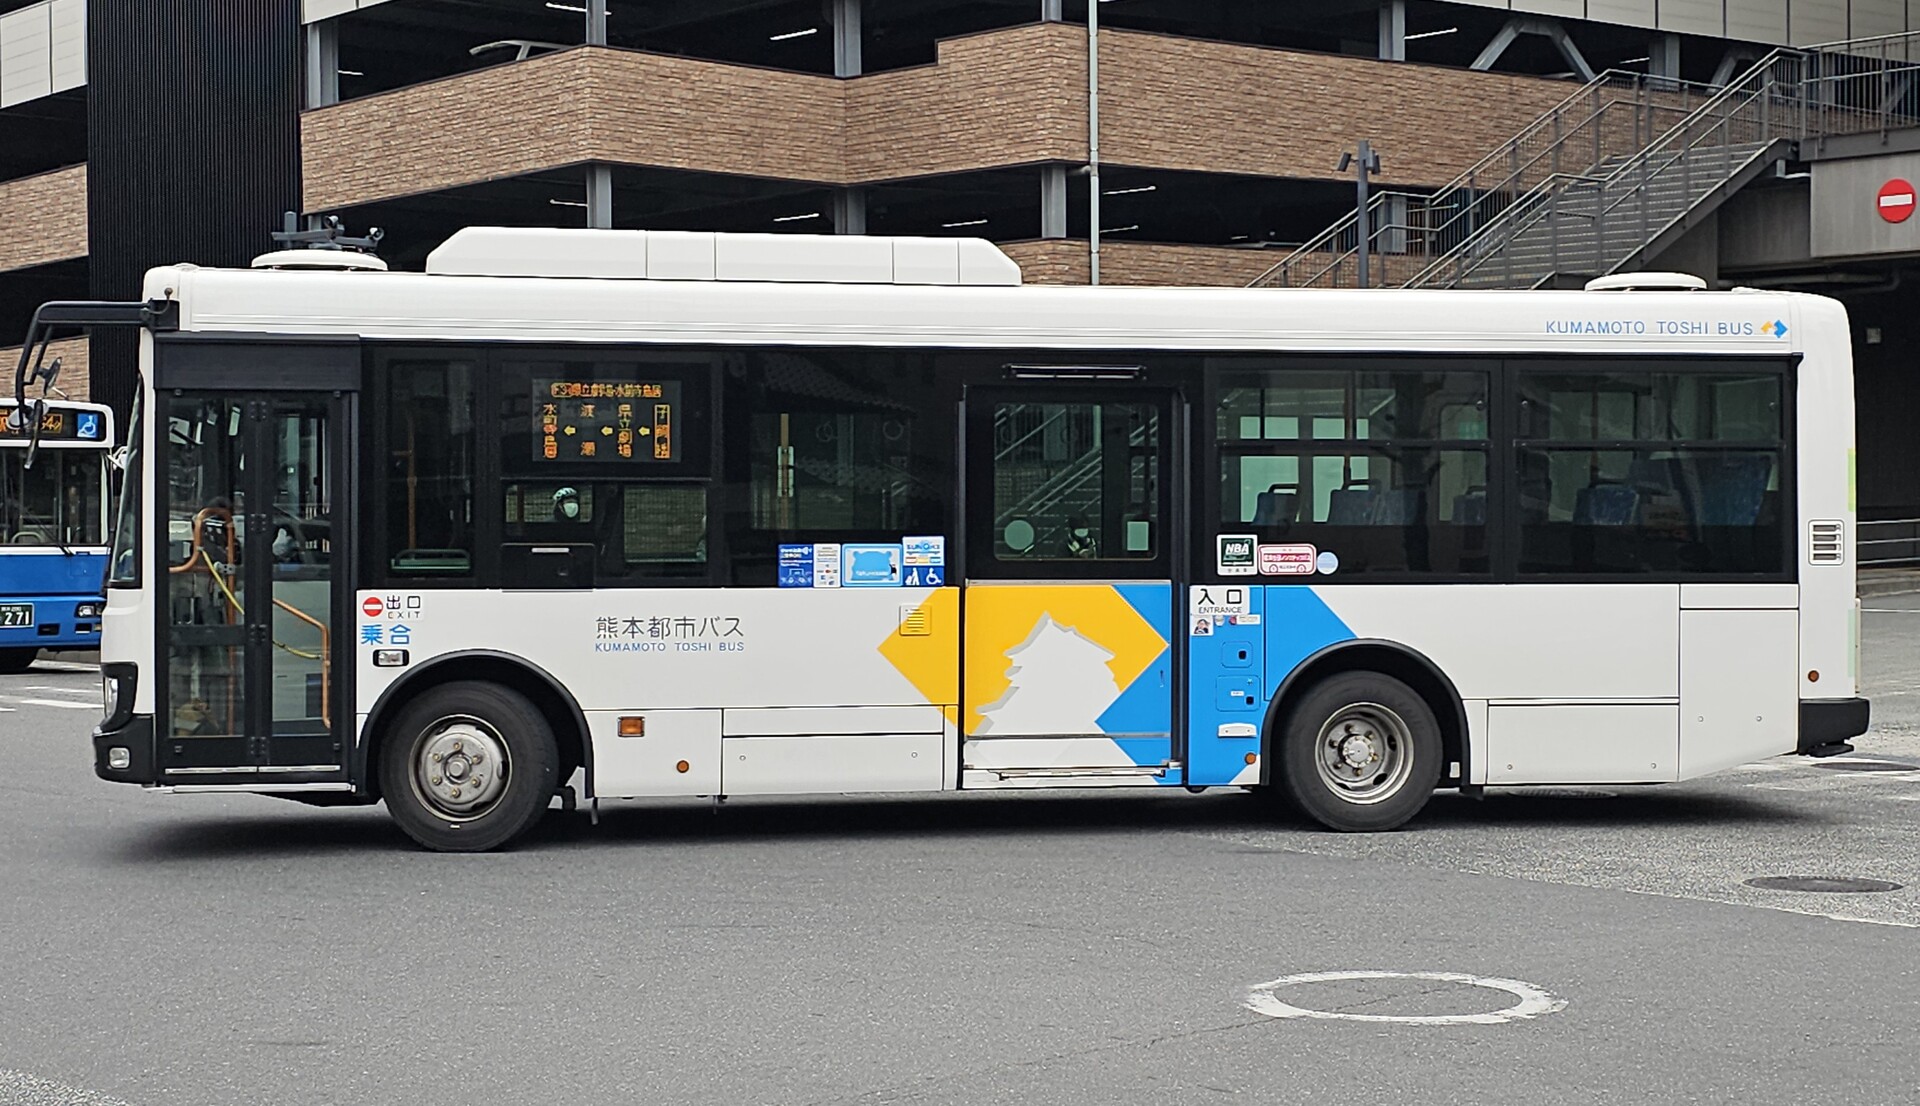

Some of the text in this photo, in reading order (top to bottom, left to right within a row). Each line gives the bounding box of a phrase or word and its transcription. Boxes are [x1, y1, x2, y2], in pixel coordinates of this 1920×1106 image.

[1545, 320, 1754, 335] KUMAMOTO TOSHI BUS
[1225, 543, 1250, 556] NBA
[386, 595, 421, 610] 出口
[1198, 588, 1242, 605] 入口
[388, 611, 420, 619] EXIT
[1198, 606, 1242, 614] ENTRANCE
[4, 611, 30, 625] 271
[361, 624, 411, 645] 乗合
[596, 616, 744, 640] 熊本都市バス
[595, 642, 745, 652] KUMAMOTO TOSHI BUS
